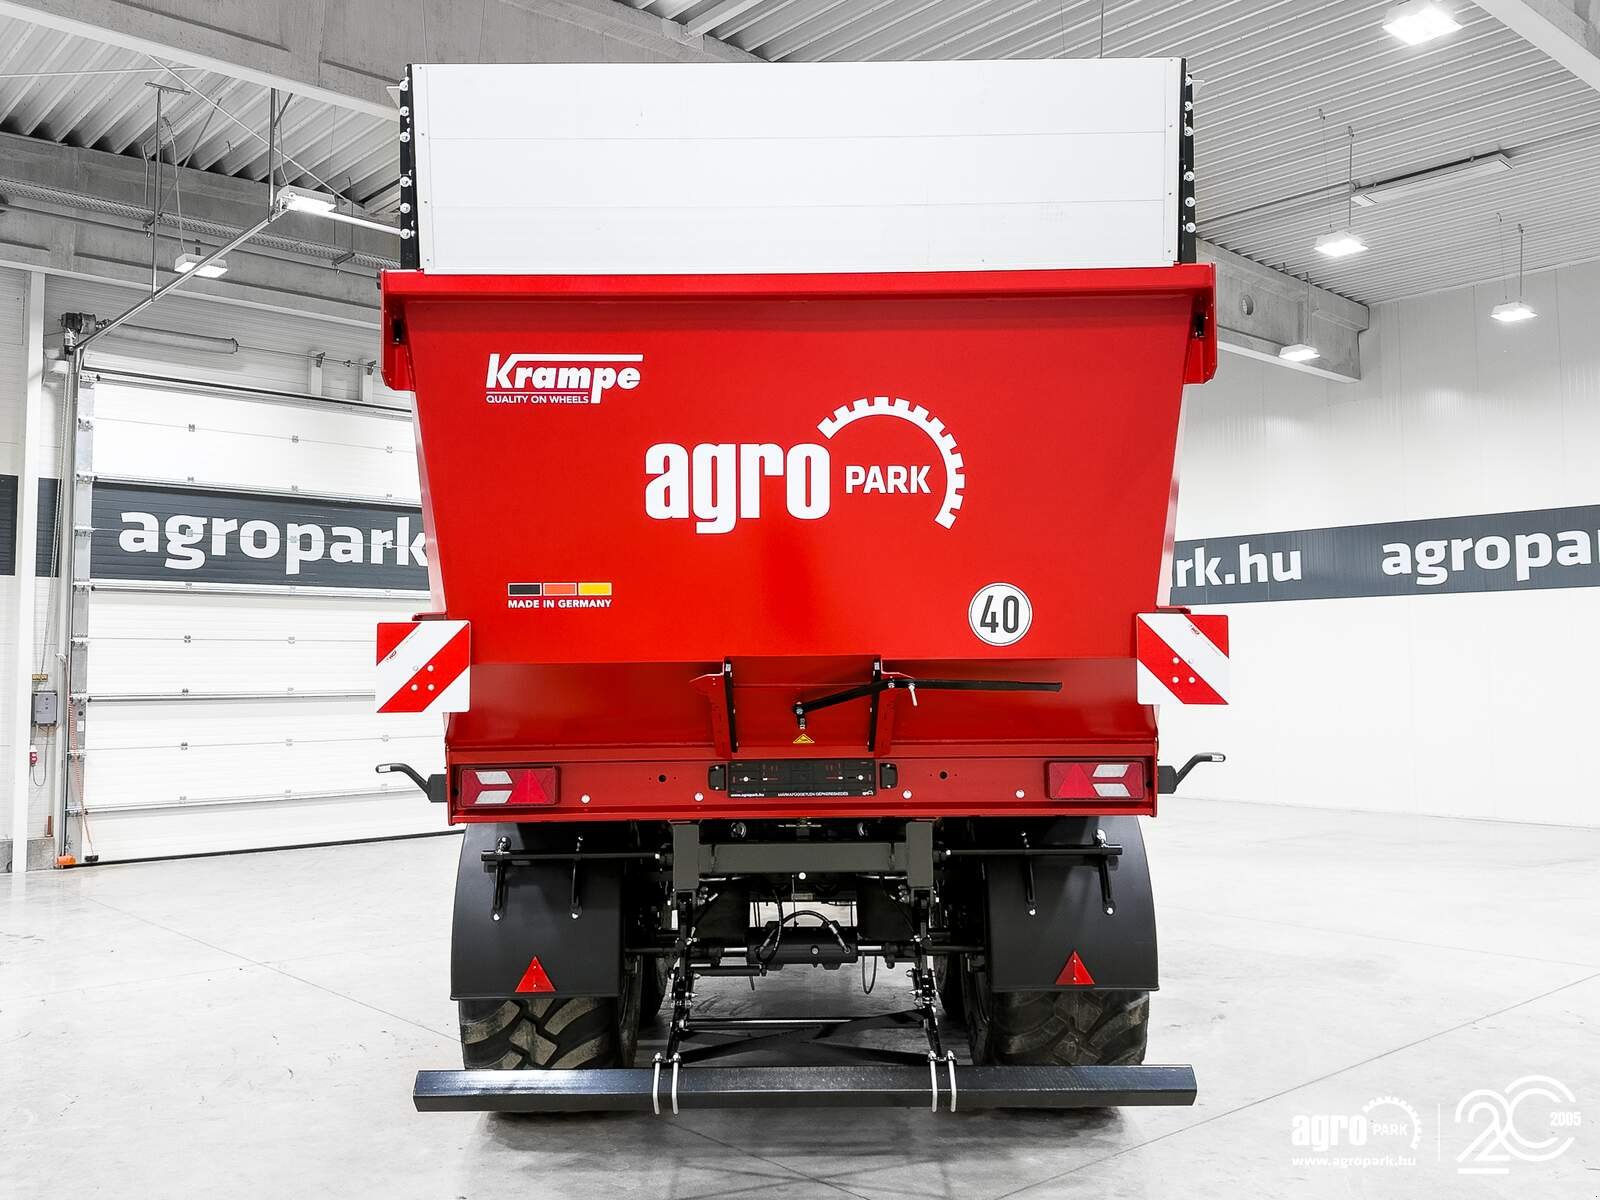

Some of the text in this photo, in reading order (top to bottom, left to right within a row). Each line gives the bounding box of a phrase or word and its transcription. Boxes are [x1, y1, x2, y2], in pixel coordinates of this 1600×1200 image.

[486, 353, 644, 404] Krampe
[486, 395, 589, 404] QUALITY ON WHEELS
[645, 443, 932, 534] agro PARK
[1381, 529, 1600, 586] agropa
[508, 599, 613, 608] MADE IN GERMANY
[979, 595, 1020, 634] 40
